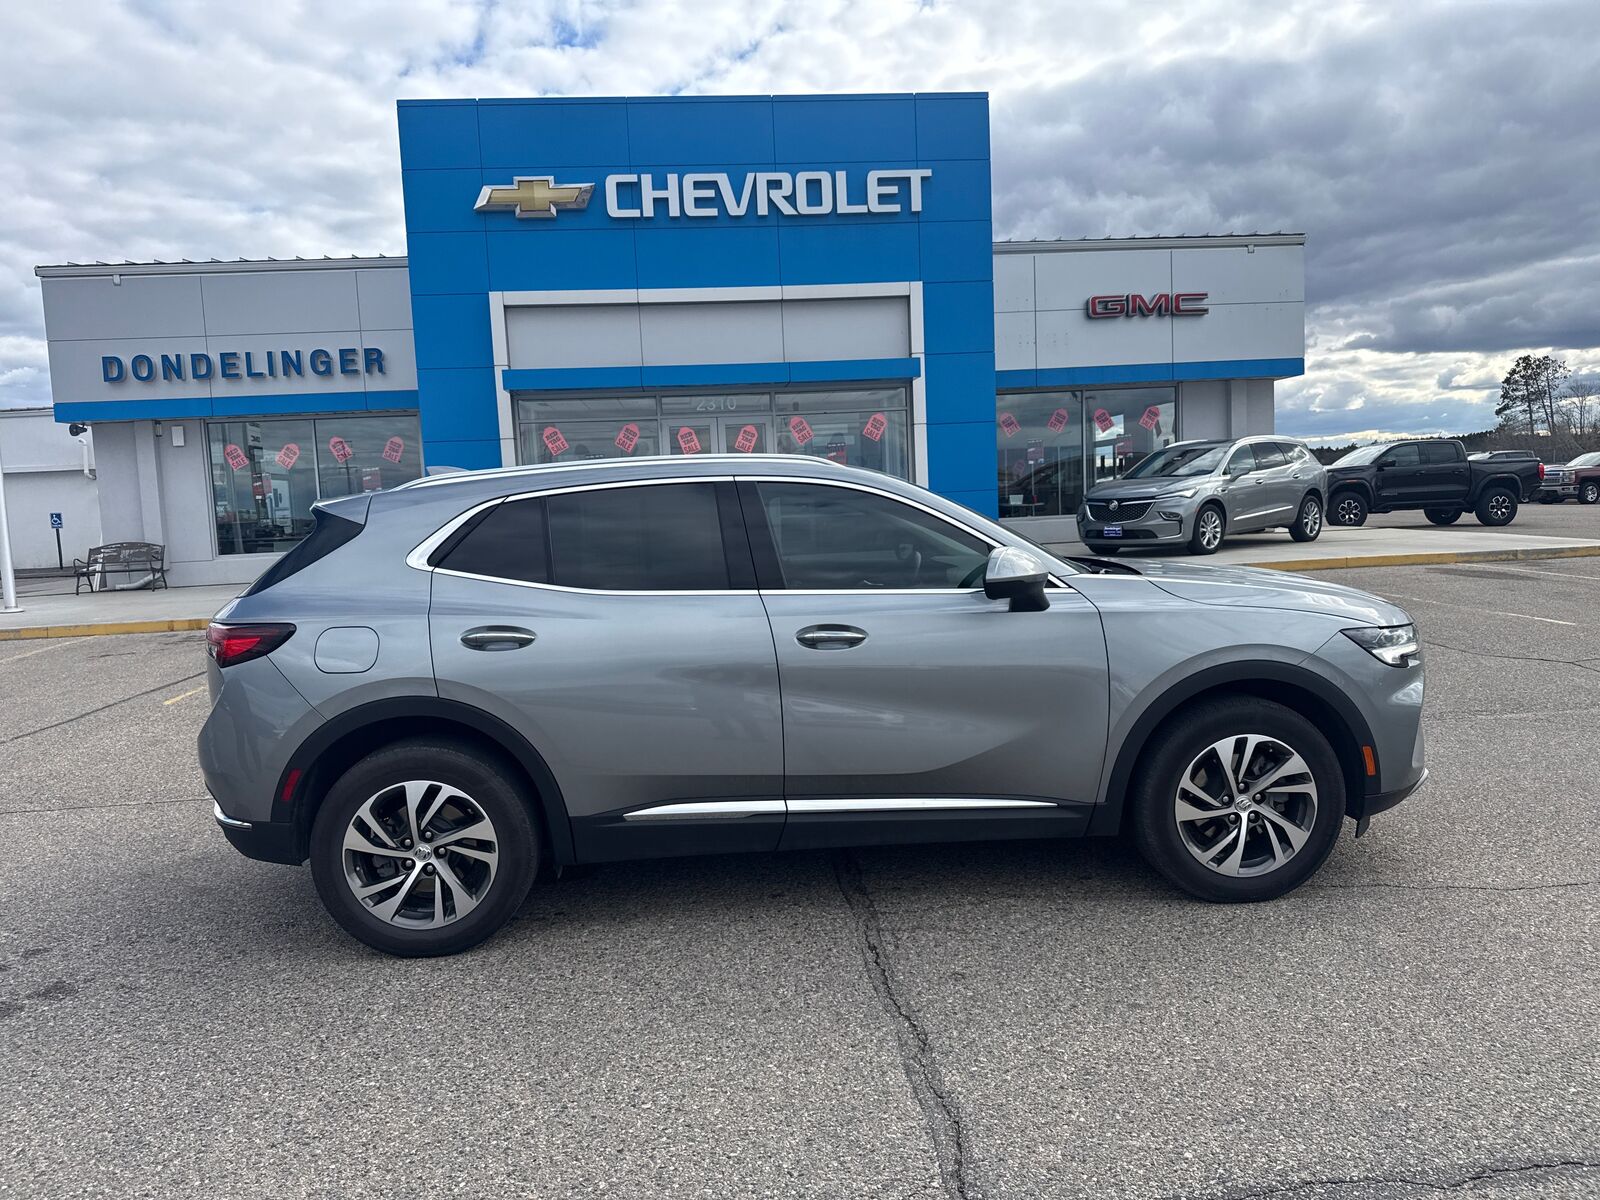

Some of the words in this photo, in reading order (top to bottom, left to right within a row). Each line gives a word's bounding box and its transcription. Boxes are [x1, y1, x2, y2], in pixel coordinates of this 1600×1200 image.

[605, 169, 932, 217] CHEVROLET
[1087, 292, 1209, 317] GMC
[102, 347, 386, 383] DONDELINGER
[792, 421, 803, 430] RED
[872, 417, 884, 426] RED
[870, 423, 881, 431] TAG
[546, 431, 557, 440] RED
[625, 428, 637, 437] RED
[680, 432, 692, 440] RED
[743, 430, 755, 438] RED
[798, 431, 812, 443] SALE
[865, 428, 879, 440] SALE
[549, 436, 560, 444] TAG
[622, 433, 634, 442] TAG
[682, 437, 694, 445] TAG
[551, 441, 566, 453] SALE
[617, 439, 632, 450] SALE
[684, 443, 698, 454] SALE
[736, 441, 752, 451] SALE
